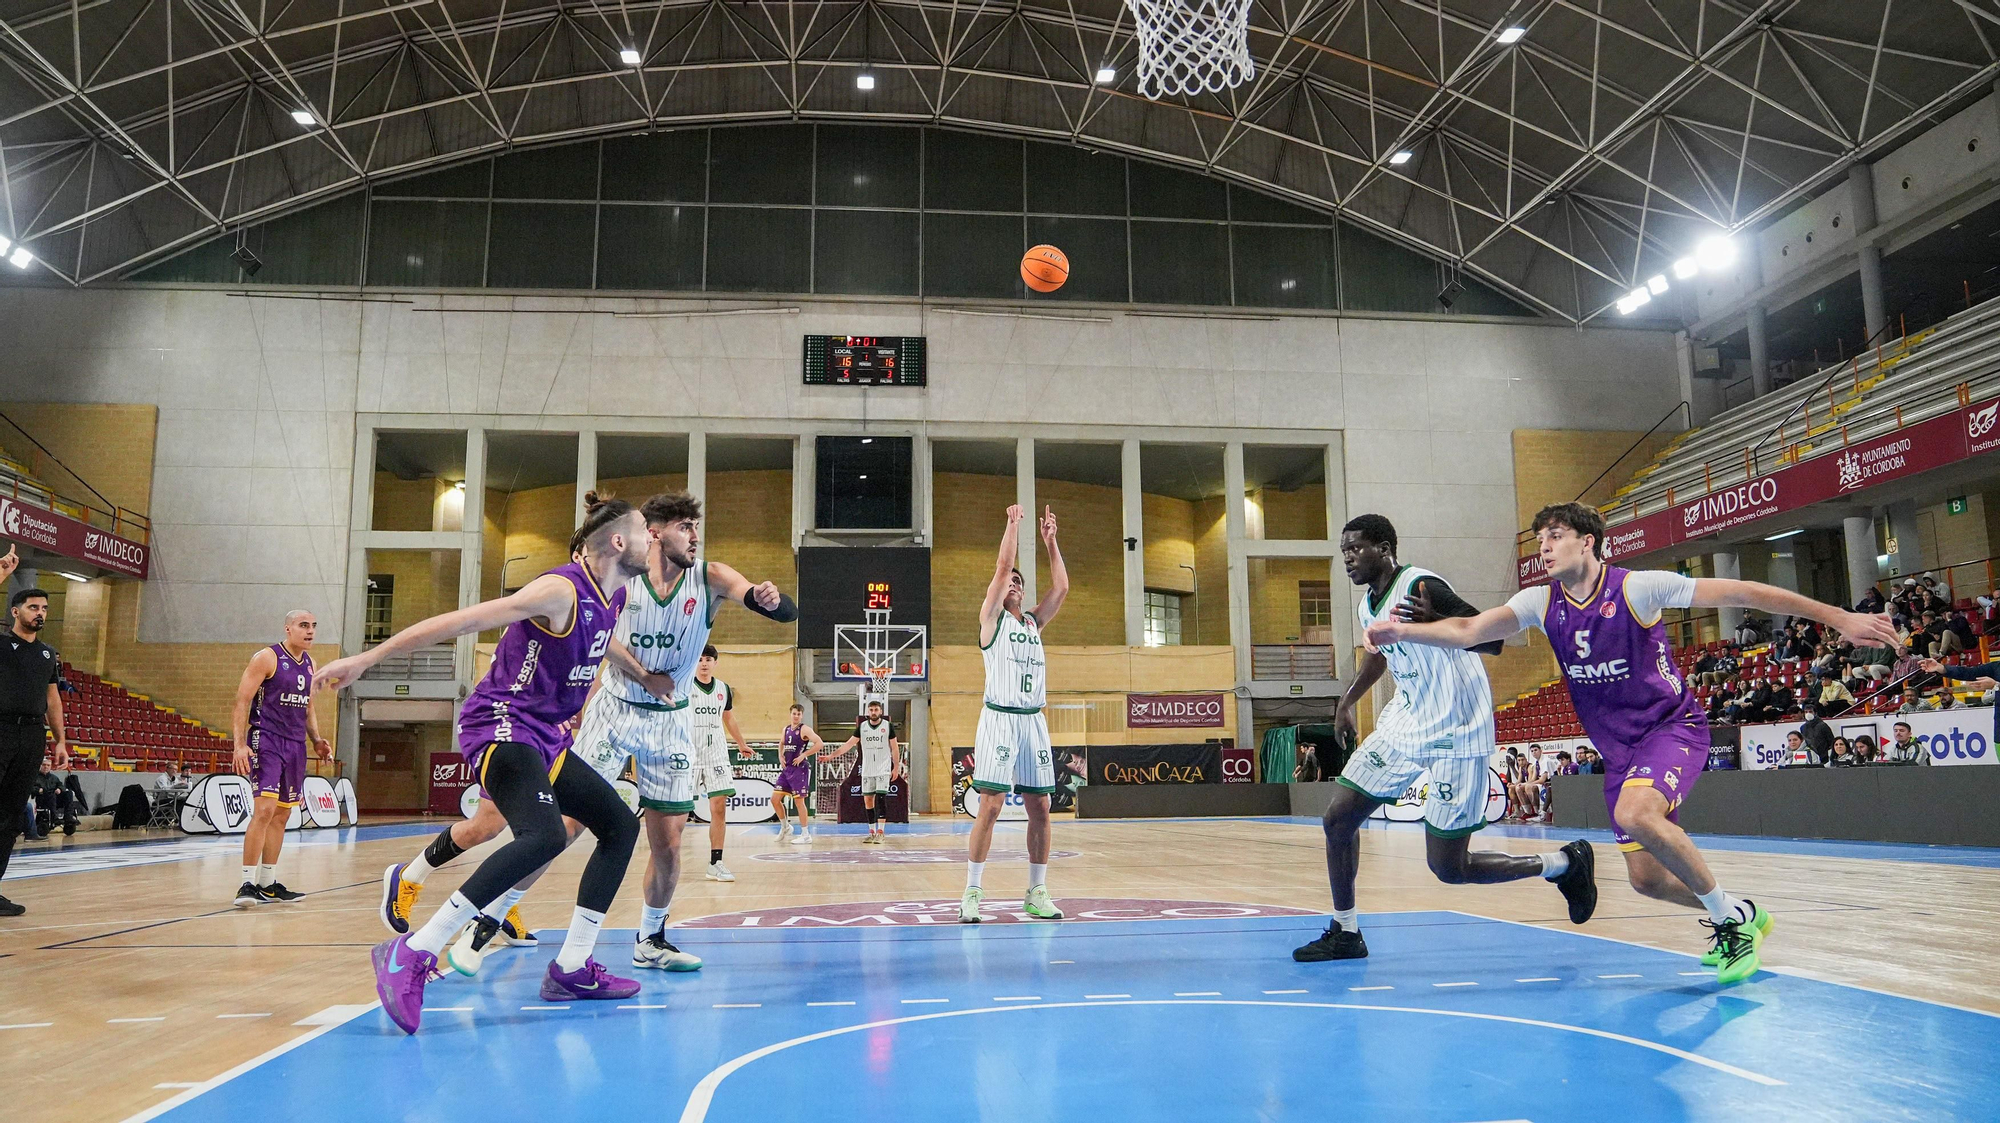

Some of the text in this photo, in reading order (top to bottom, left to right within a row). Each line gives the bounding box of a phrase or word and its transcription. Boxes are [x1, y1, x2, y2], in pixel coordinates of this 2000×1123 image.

[842, 357, 852, 366] 16
[886, 358, 894, 368] 16
[844, 369, 850, 378] 5
[887, 370, 892, 378] 3
[1862, 438, 1911, 464] AYUNTAMIENTO
[1862, 455, 1906, 478] DE CÓRDOBA
[1702, 478, 1776, 520] IMDECO
[1952, 500, 1961, 512] B
[23, 514, 58, 534] Diputación
[1686, 528, 1704, 538] Instituto
[1704, 521, 1726, 533] Municipal
[1734, 512, 1756, 524] Deportes
[1756, 506, 1778, 517] Córdoba
[22, 527, 57, 546] de Córdoba
[1612, 528, 1644, 546] Diputación
[99, 535, 144, 565] IMDECO
[1614, 539, 1646, 556] de Córdoba
[868, 594, 888, 608] 24
[630, 631, 676, 649] coto
[1574, 630, 1592, 659] 5
[518, 639, 538, 682] aspasia
[297, 674, 306, 691] 9
[1020, 674, 1032, 693] 16
[1660, 655, 1682, 694] aspasia
[694, 706, 717, 714] coto
[1152, 702, 1220, 716] IMDECO
[708, 734, 712, 747] 11
[225, 794, 244, 814] RG3
[318, 792, 335, 808] rahi
[726, 794, 770, 811] episur
